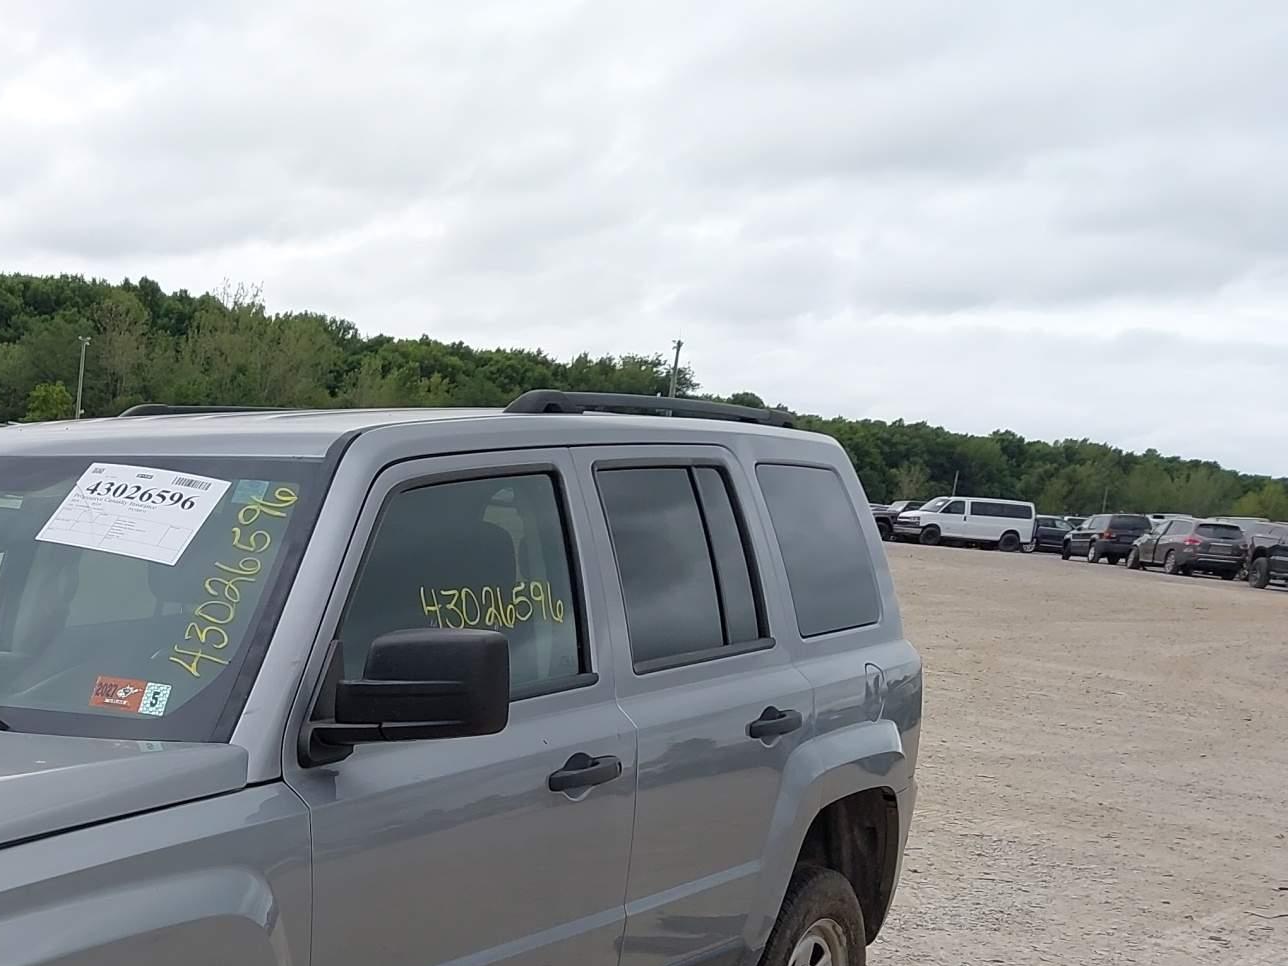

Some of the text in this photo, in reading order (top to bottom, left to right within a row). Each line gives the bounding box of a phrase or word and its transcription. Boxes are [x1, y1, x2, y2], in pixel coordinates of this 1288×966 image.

[86, 480, 200, 510] 43026596
[169, 487, 299, 677] 43026596
[420, 581, 563, 629] 43026596
[149, 691, 160, 707] 5
